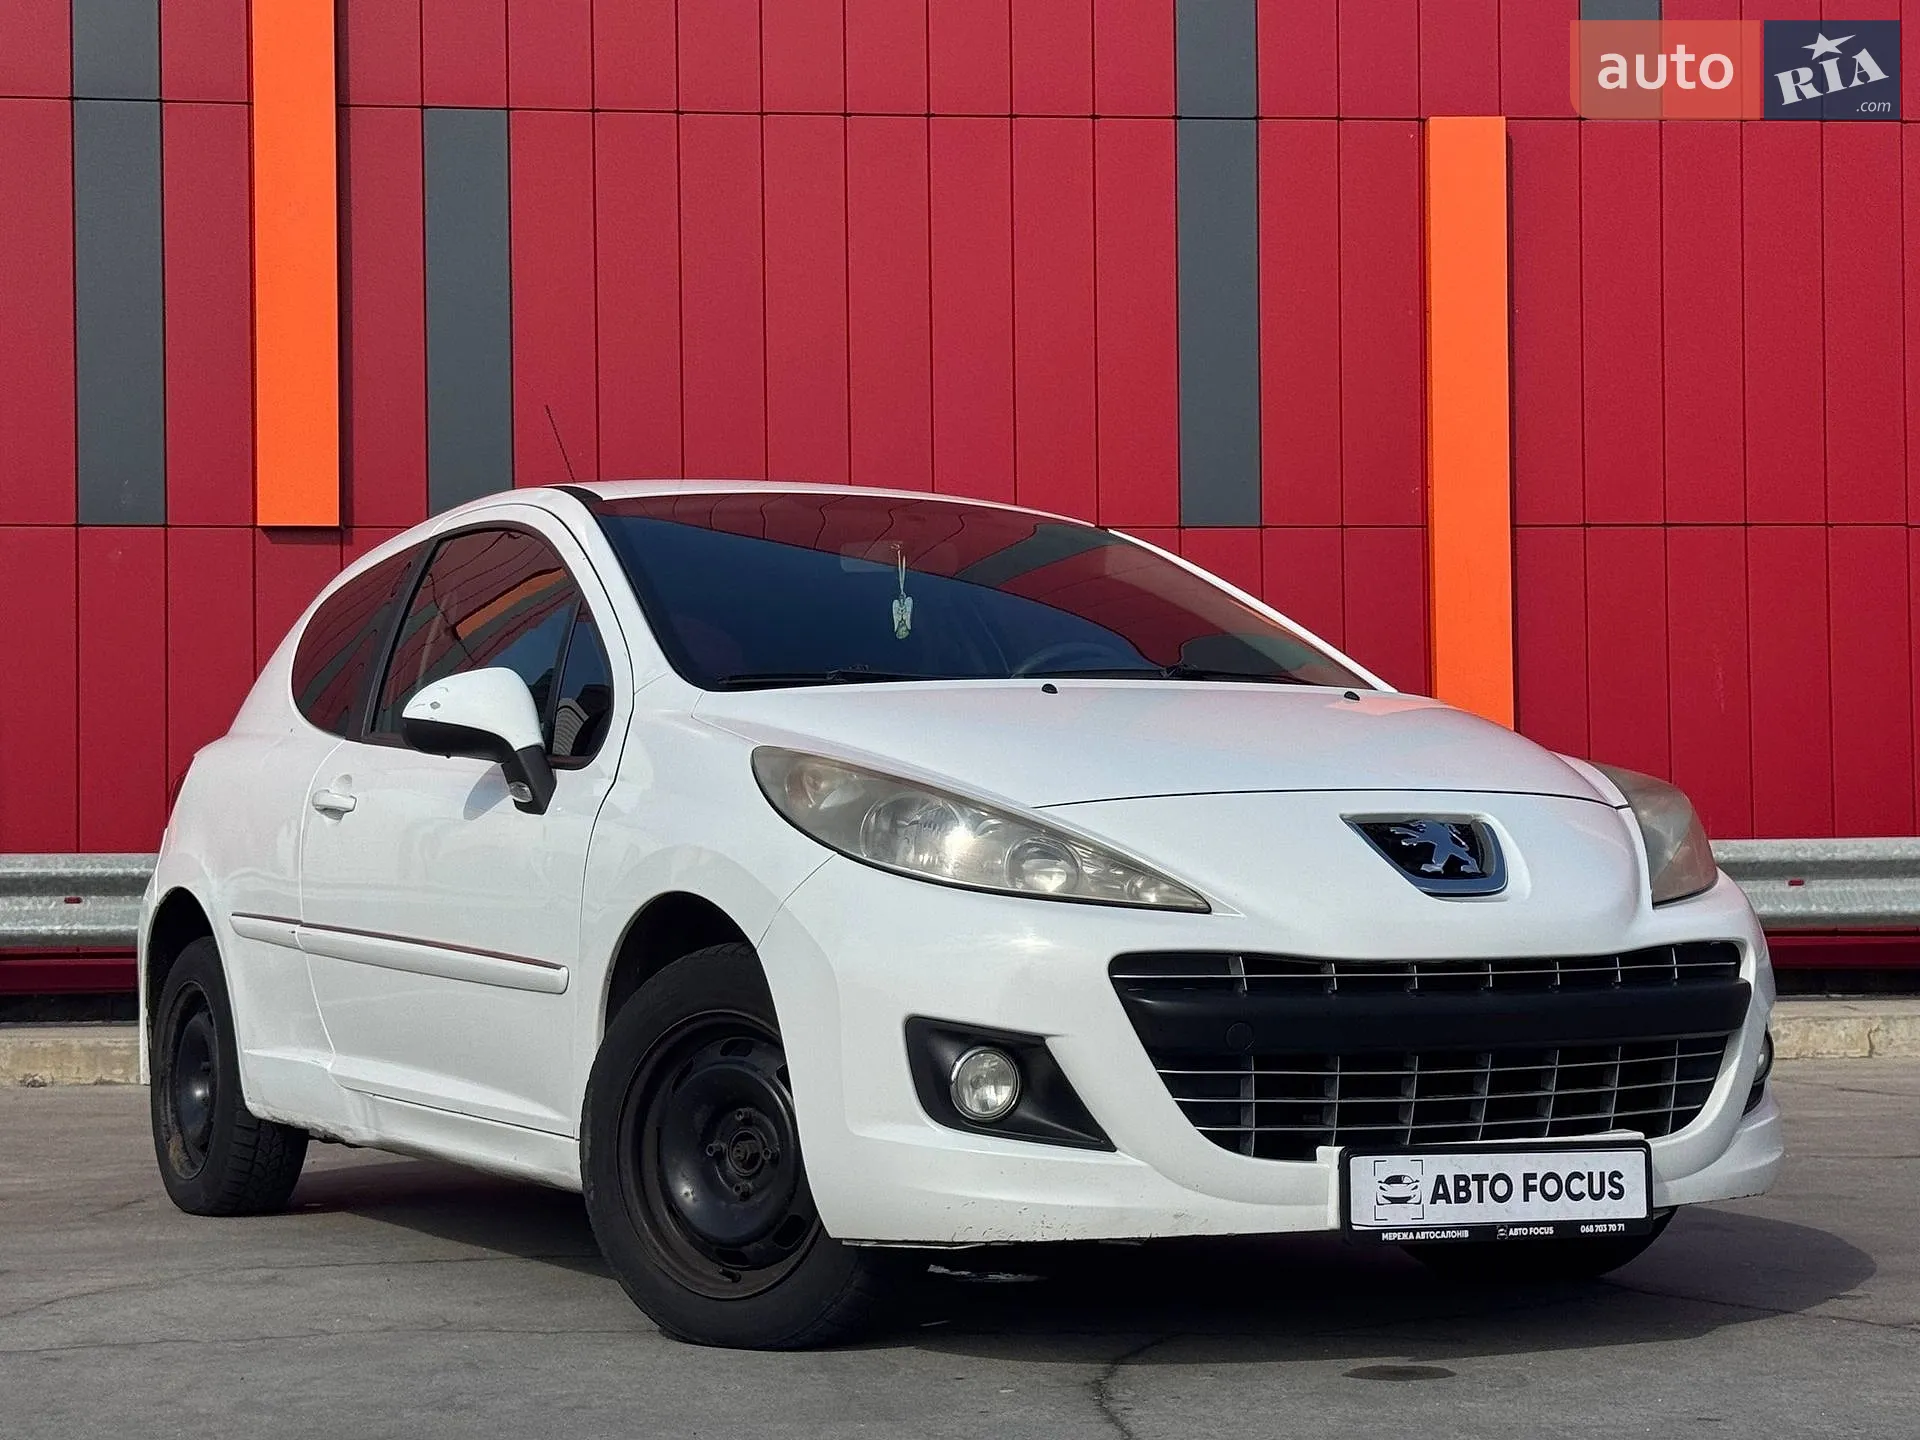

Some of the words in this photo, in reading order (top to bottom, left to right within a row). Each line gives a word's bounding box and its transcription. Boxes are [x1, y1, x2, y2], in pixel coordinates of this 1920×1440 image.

[1430, 1172, 1514, 1205] АВТО
[1522, 1170, 1625, 1202] FOCUS
[1529, 1225, 1554, 1235] FOCUS
[1580, 1224, 1594, 1234] 068
[1594, 1224, 1607, 1233] 703
[1608, 1223, 1617, 1233] 70
[1617, 1223, 1625, 1232] 71
[1382, 1231, 1414, 1241] МЕРЕЖА
[1415, 1229, 1469, 1239] АВТОСАЛОНІВ
